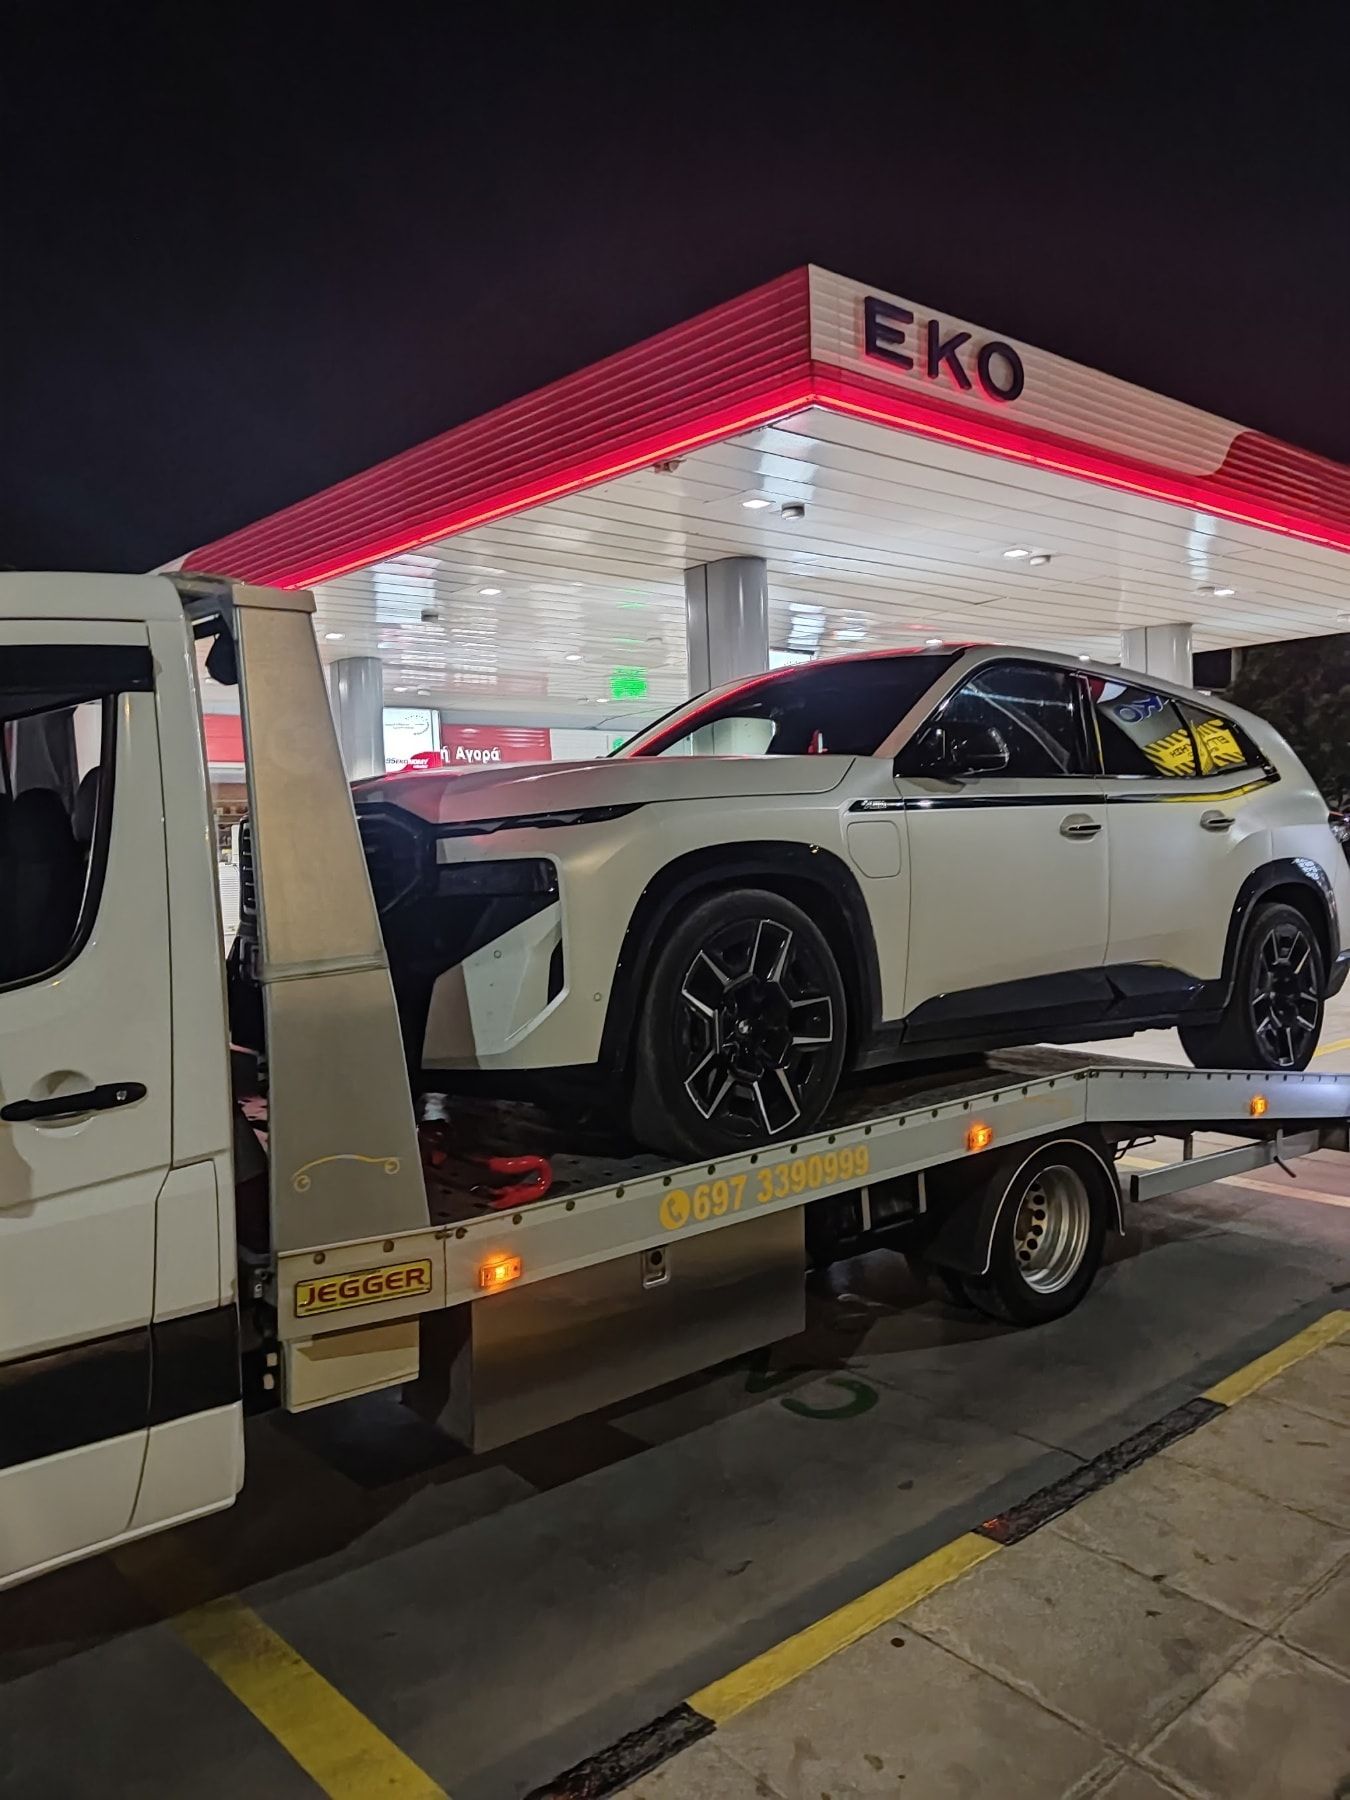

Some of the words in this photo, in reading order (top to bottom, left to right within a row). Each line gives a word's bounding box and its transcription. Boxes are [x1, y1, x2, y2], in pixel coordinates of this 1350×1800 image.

[864, 295, 1025, 402] EKO
[455, 745, 501, 764] Αγορά
[693, 1173, 748, 1221] 697
[756, 1144, 870, 1204] 3390999
[298, 1266, 425, 1308] JEGGER
